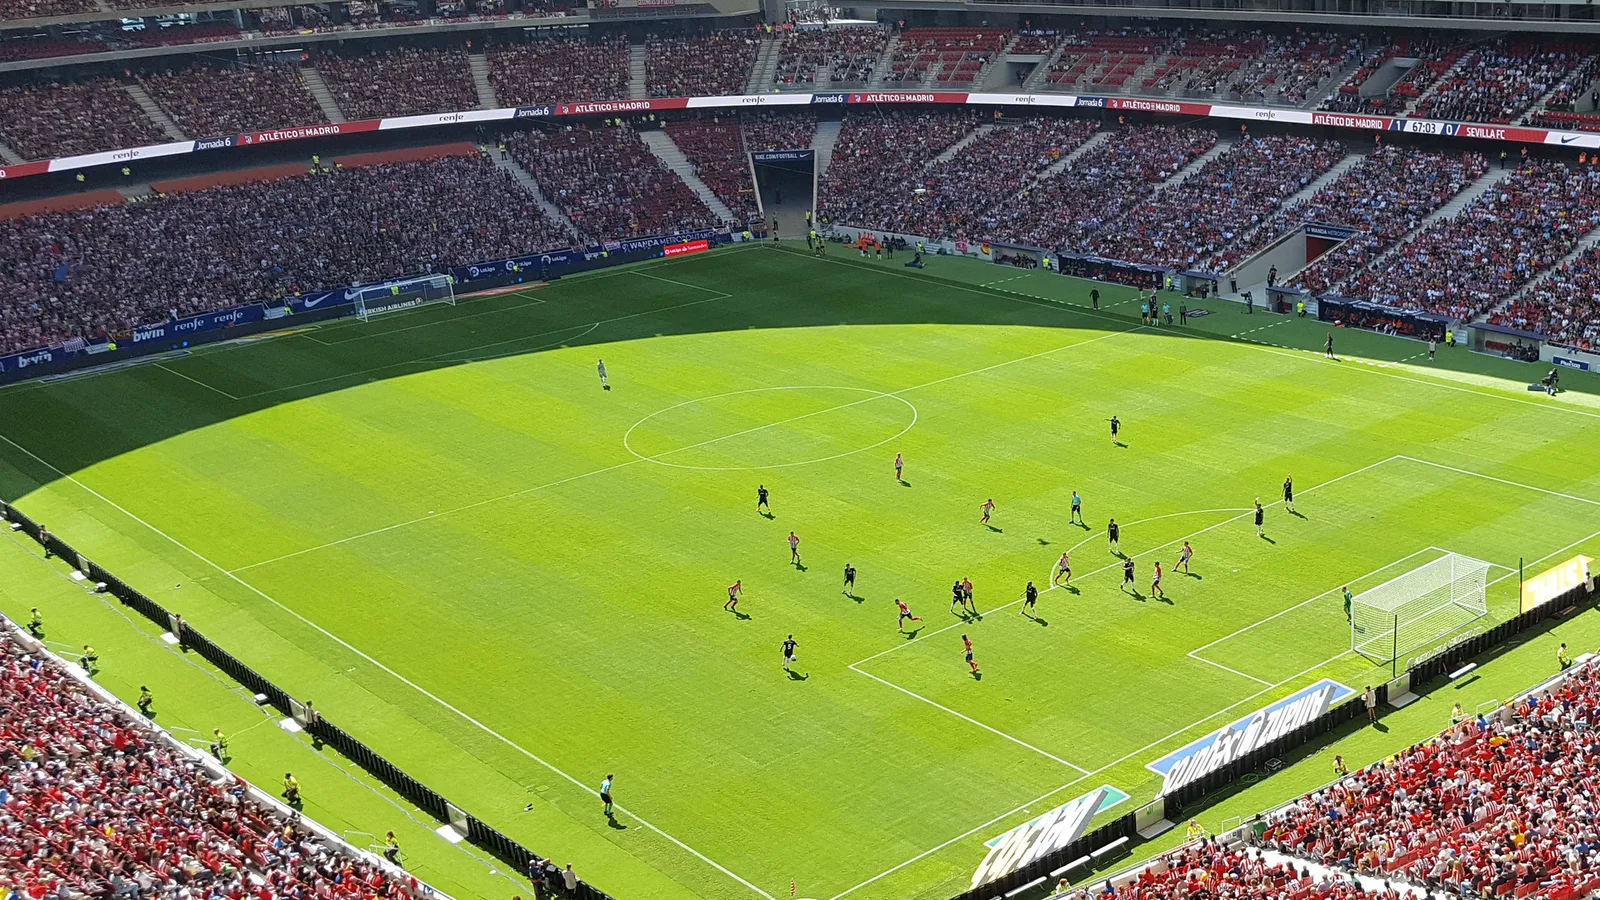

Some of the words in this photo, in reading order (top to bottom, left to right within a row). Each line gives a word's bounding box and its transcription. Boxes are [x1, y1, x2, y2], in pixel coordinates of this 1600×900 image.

[742, 95, 766, 106] renfe
[814, 94, 837, 103] Jornada
[837, 94, 843, 103] 6
[866, 93, 899, 102] ATLÉTICO
[906, 94, 935, 102] MADRID
[1015, 95, 1036, 106] renfe
[1077, 99, 1097, 107] Jornada
[1098, 98, 1103, 107] 6
[517, 107, 543, 118] Jornada
[543, 106, 549, 116] 6
[575, 103, 612, 113] ATLÉTICO
[618, 101, 650, 111] MADRID
[1122, 100, 1150, 110] ATLÉTICO
[1155, 103, 1181, 112] MADRID
[438, 112, 464, 124] renfe
[1255, 109, 1276, 120] renfe
[1314, 114, 1344, 127] ATLÉTICO
[1345, 117, 1355, 128] DE
[1355, 118, 1383, 130] MADRID
[1412, 121, 1436, 134] 67:03
[259, 130, 298, 142] ATLÉTICO
[305, 125, 340, 137] MADRID
[1445, 124, 1453, 136] 0
[1466, 126, 1496, 139] SEVILLA
[1496, 129, 1505, 140] FC
[197, 138, 224, 151] Jornada
[225, 137, 231, 147] 6
[112, 149, 140, 161] renfe
[629, 238, 660, 250] WANDA
[387, 300, 416, 311] AIRLINES
[214, 310, 244, 323] renfe
[174, 318, 205, 331] renfe
[133, 327, 165, 343] bwin
